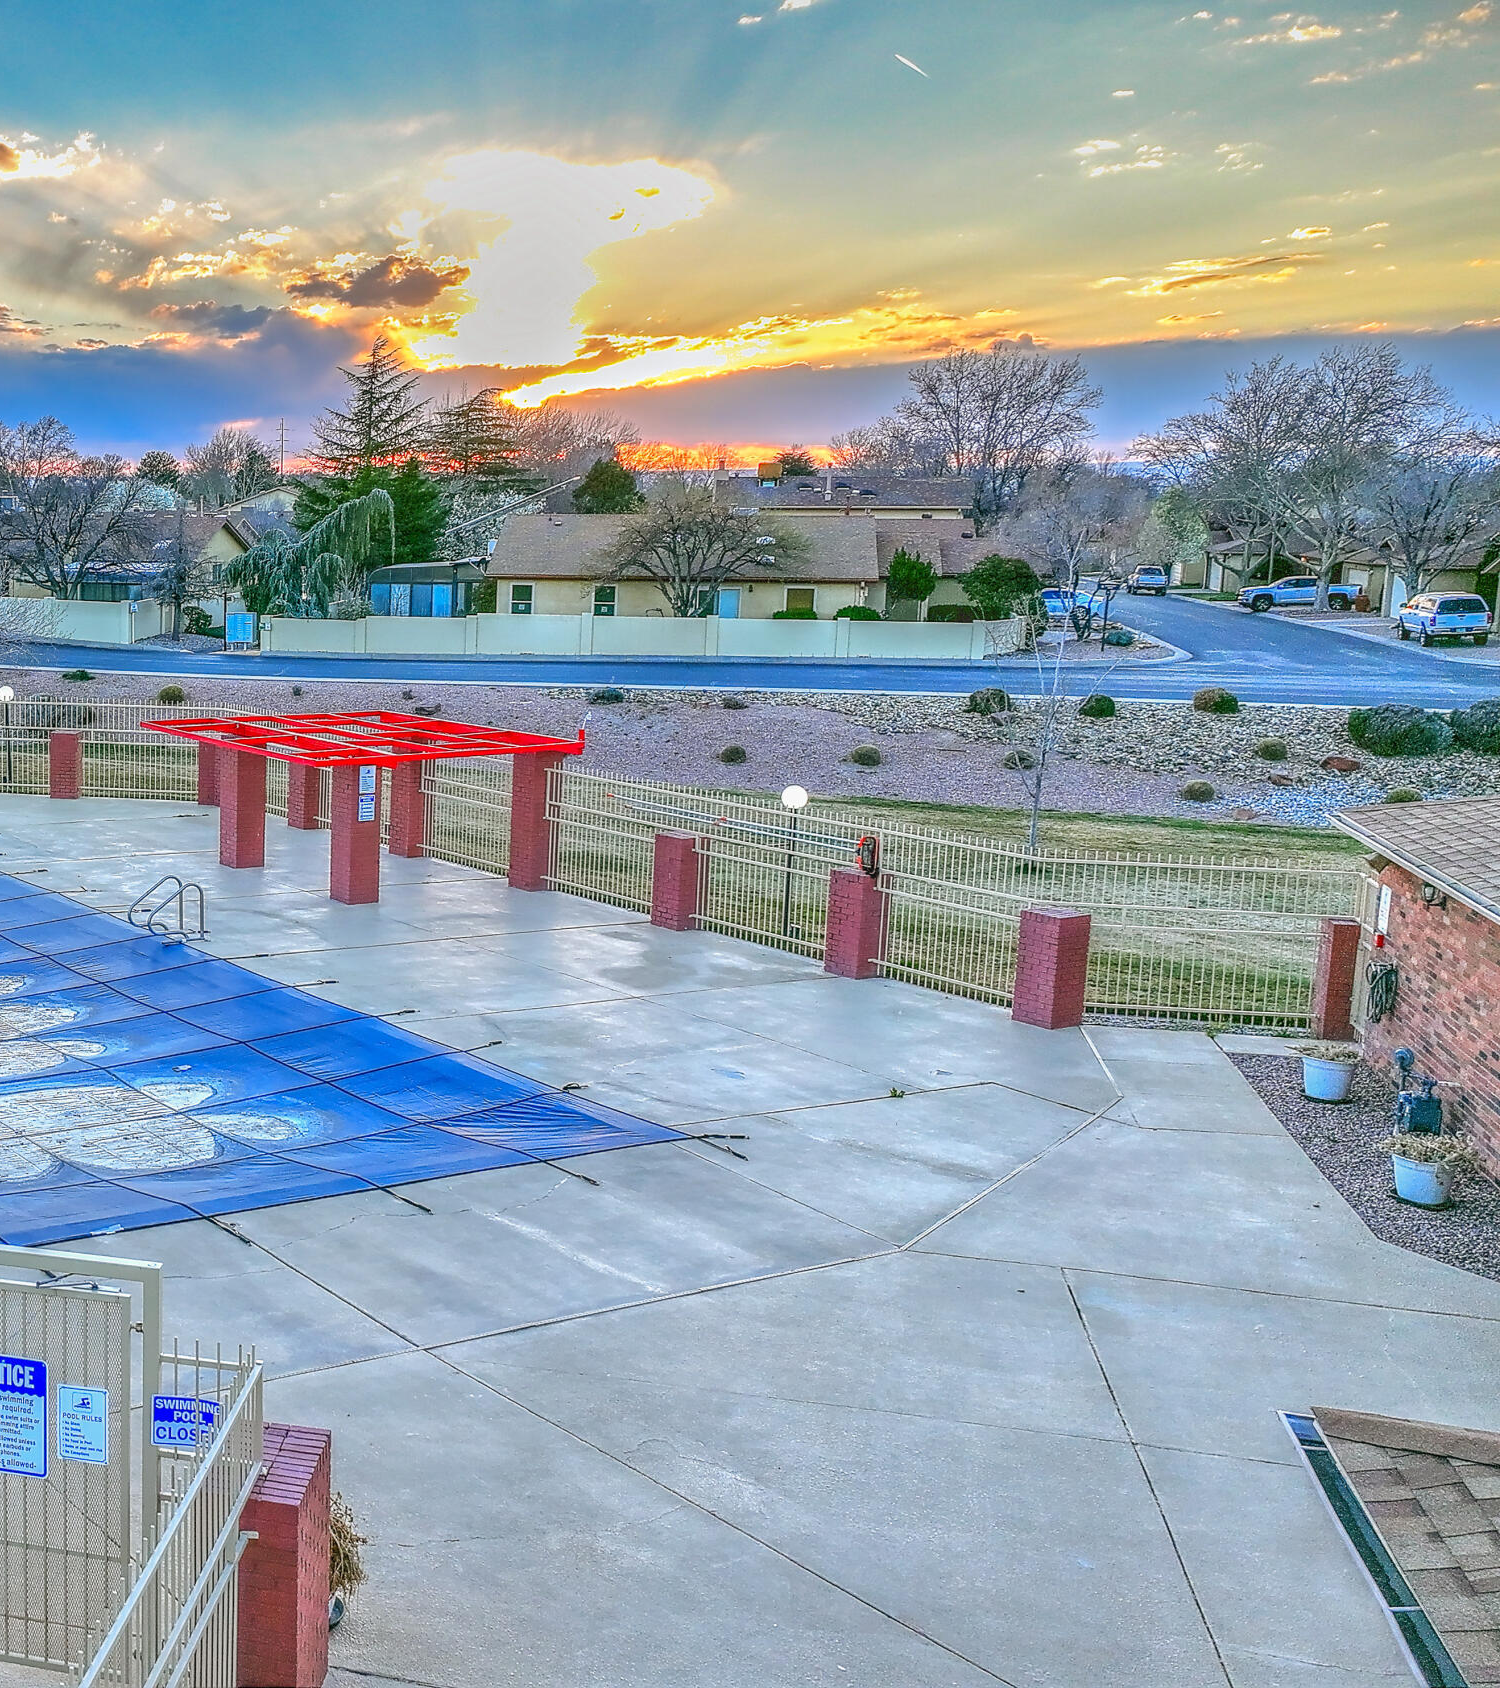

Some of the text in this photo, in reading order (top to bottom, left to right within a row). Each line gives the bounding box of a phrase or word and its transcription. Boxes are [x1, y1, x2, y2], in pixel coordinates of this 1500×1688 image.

[0, 1394, 34, 1407] swimming
[155, 1398, 220, 1415] SWIMMING
[2, 1404, 34, 1415] required.
[62, 1412, 79, 1420] POOL
[173, 1410, 206, 1424] POOL
[155, 1426, 211, 1442] CLOSE
[2, 1443, 24, 1451] earbuds
[19, 1438, 36, 1446] unless
